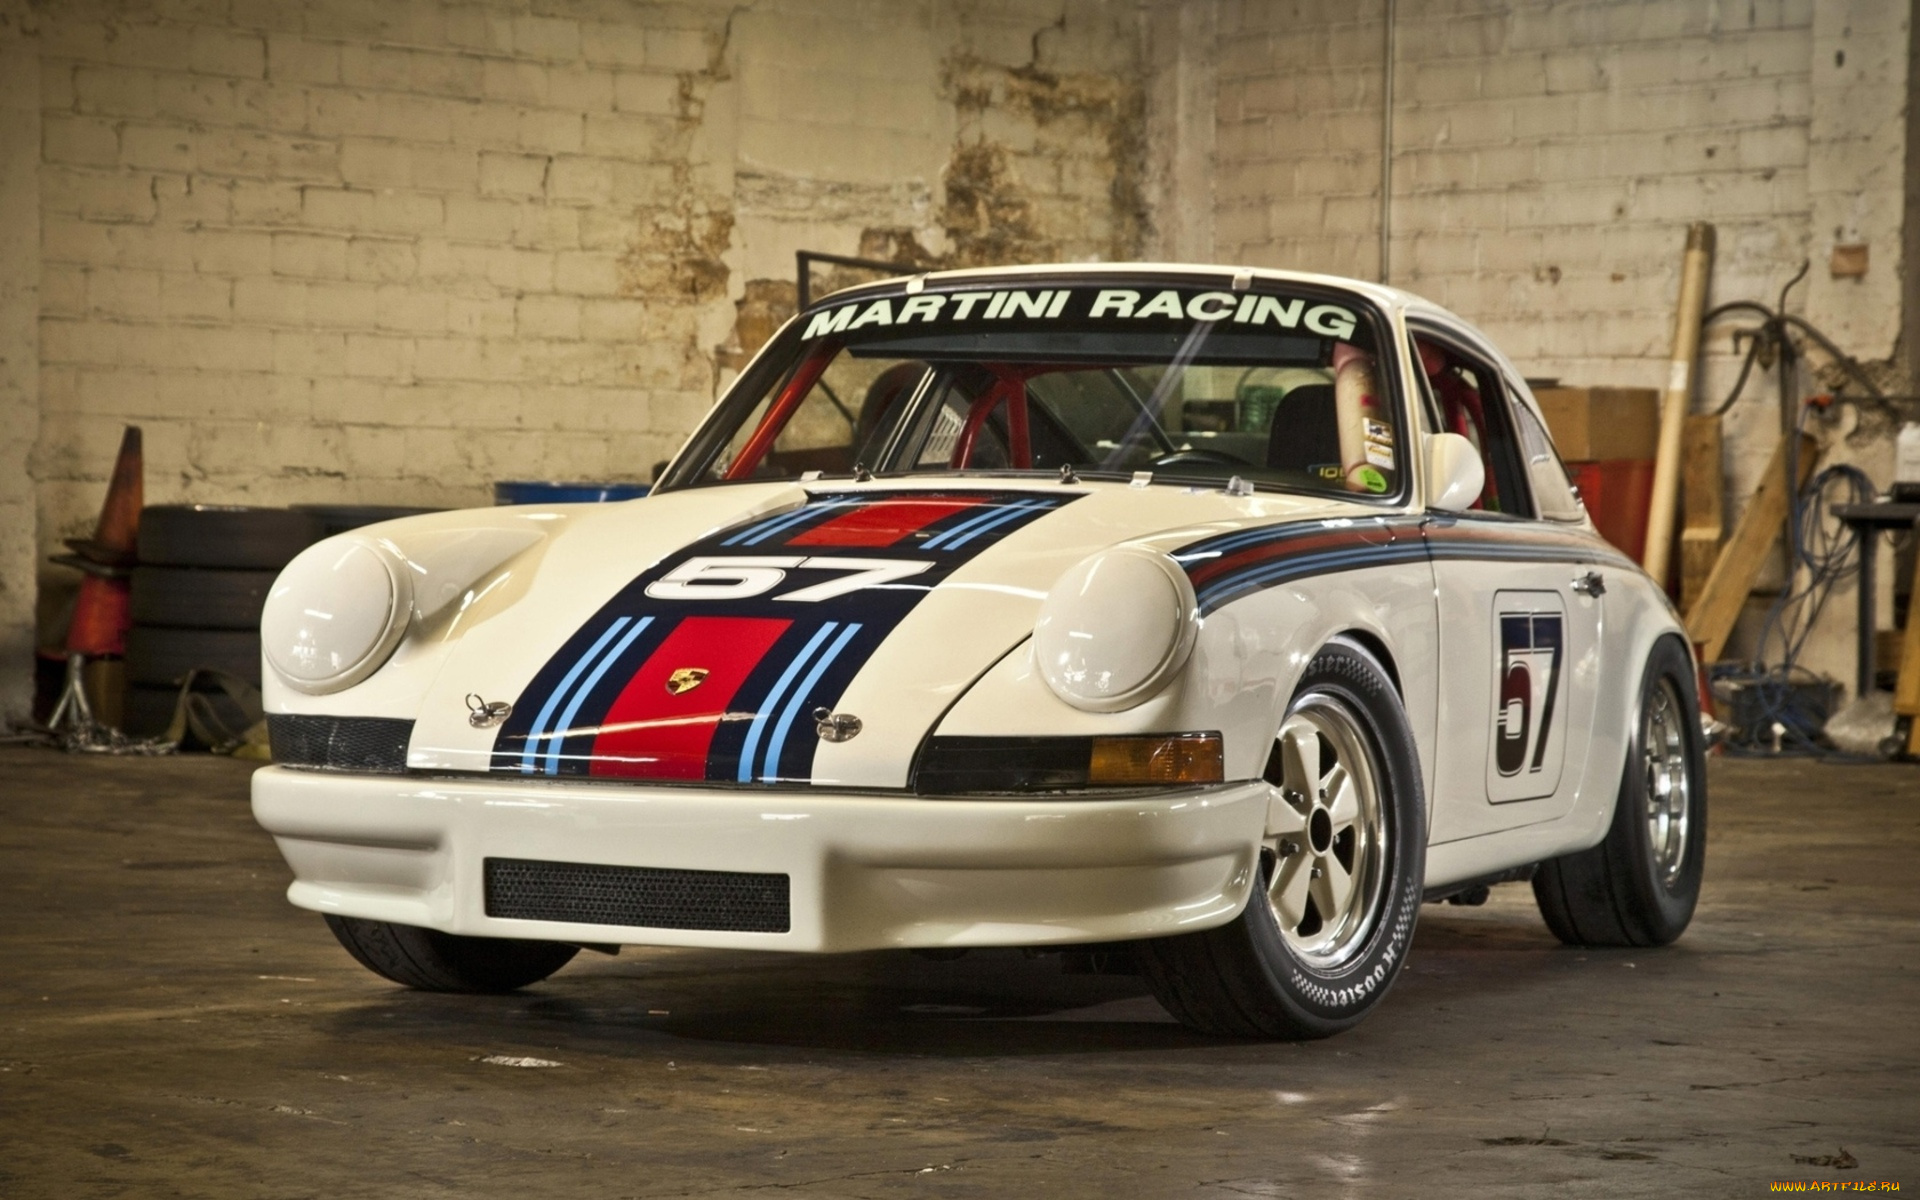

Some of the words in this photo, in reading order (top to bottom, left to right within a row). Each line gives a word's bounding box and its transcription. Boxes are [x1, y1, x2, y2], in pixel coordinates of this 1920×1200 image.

[801, 290, 1072, 341] MARTINI
[1088, 290, 1357, 341] RACING
[644, 556, 937, 602] 57
[1496, 612, 1563, 778] 57
[1330, 941, 1400, 1007] Hoosier
